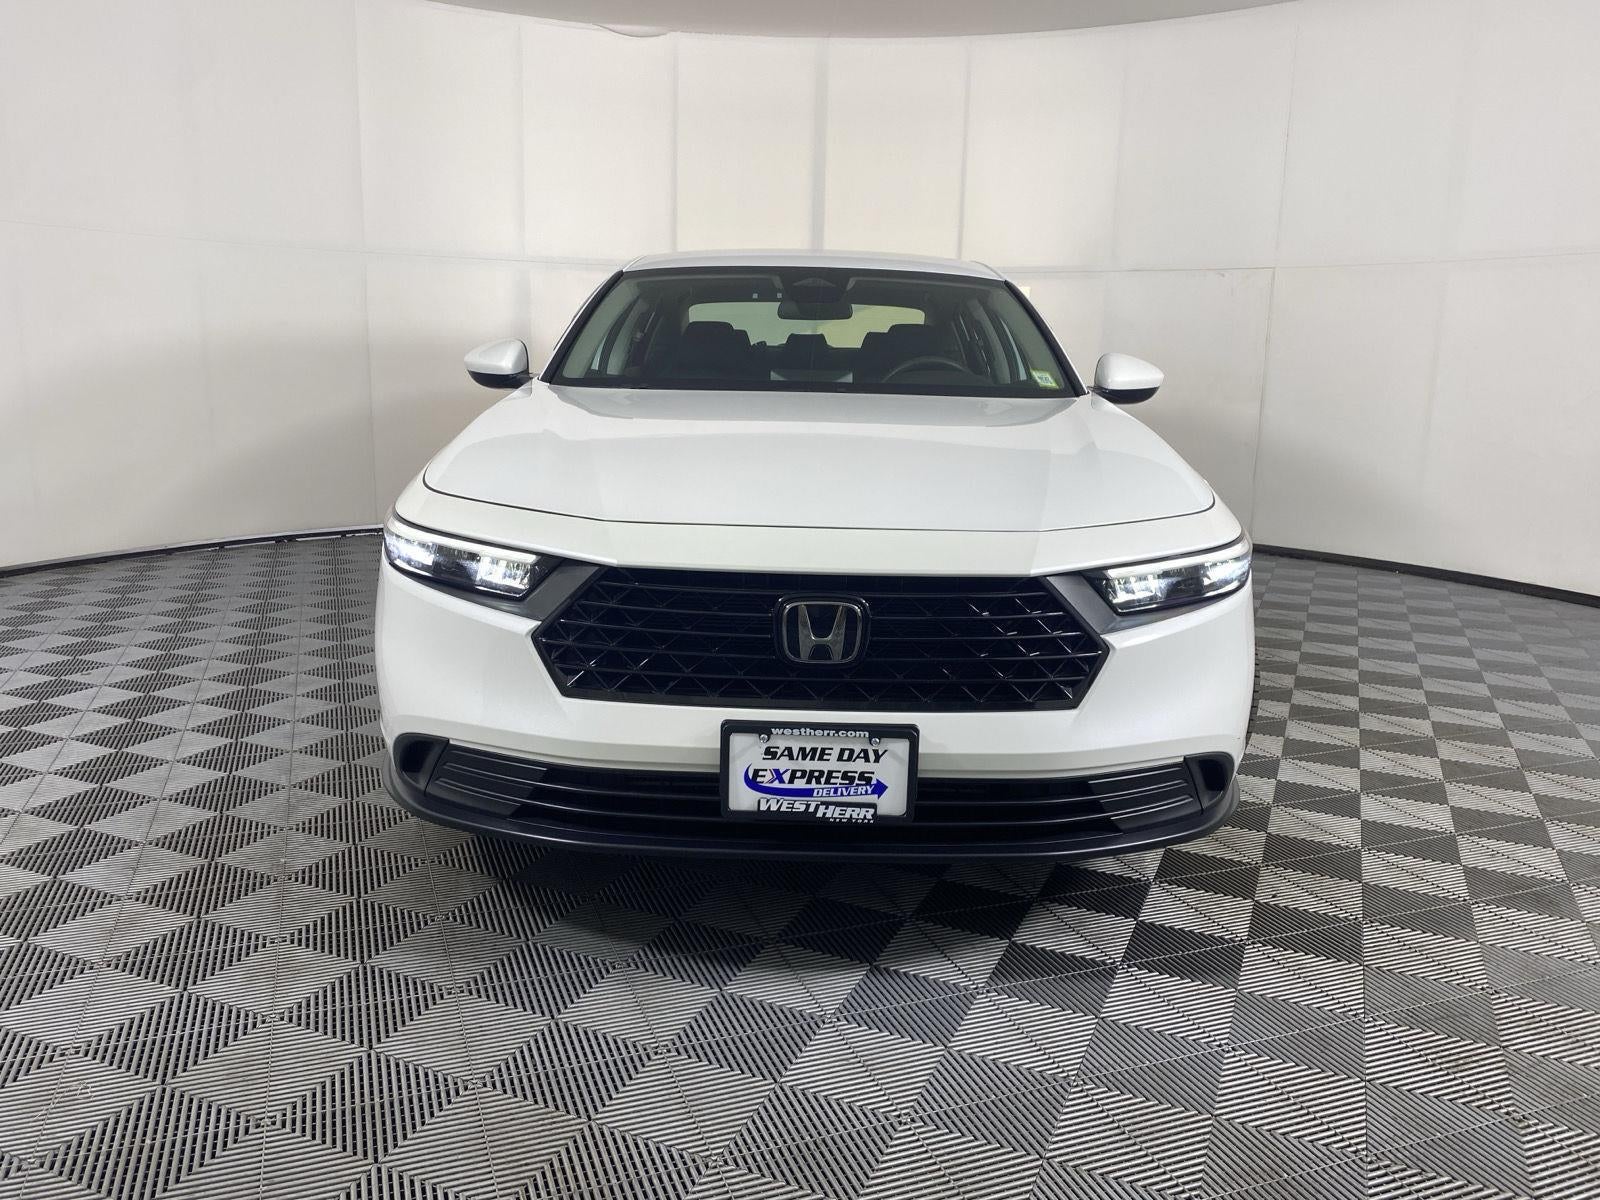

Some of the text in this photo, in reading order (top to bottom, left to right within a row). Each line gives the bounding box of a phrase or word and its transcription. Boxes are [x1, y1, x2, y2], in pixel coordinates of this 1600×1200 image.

[771, 727, 869, 738] westherr.com
[762, 746, 888, 764] SAME DAY
[751, 768, 875, 786] EXPRESS
[812, 785, 875, 797] DELIVERY
